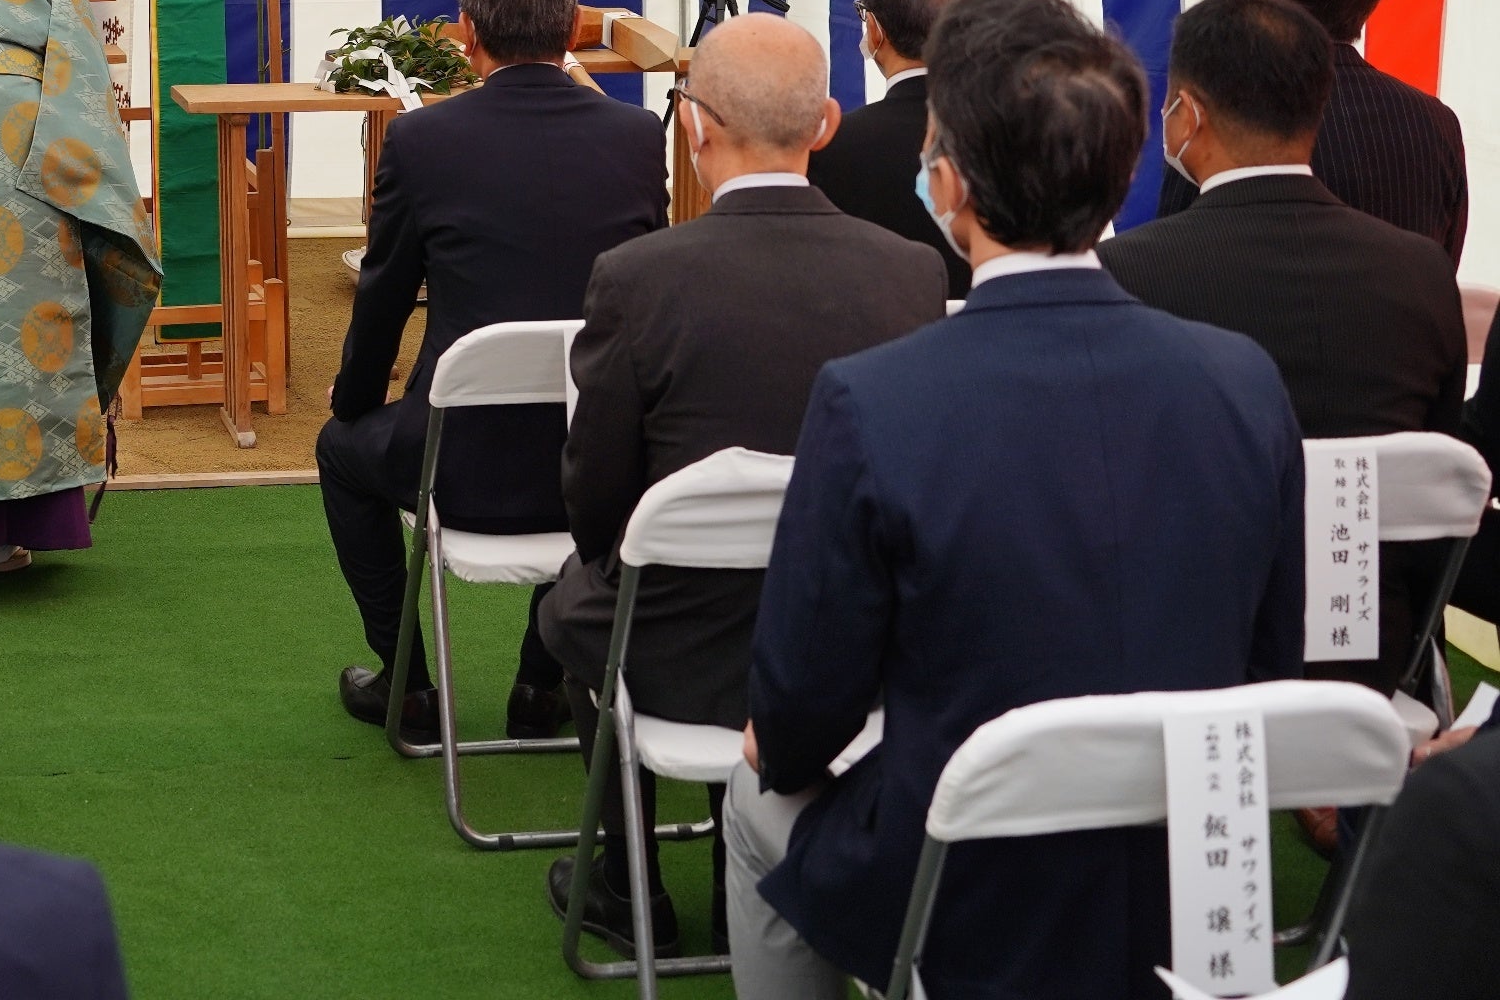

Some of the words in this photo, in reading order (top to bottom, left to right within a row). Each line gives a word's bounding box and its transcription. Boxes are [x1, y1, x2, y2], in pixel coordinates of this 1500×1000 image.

[1334, 458, 1347, 508] 取締役
[1355, 456, 1371, 521] 株式会社
[1331, 524, 1351, 564] 池田
[1357, 543, 1371, 621] サワライズ
[1235, 721, 1257, 808] 株式会社
[1203, 813, 1230, 869] 飯田
[1240, 836, 1263, 943] サワライズ
